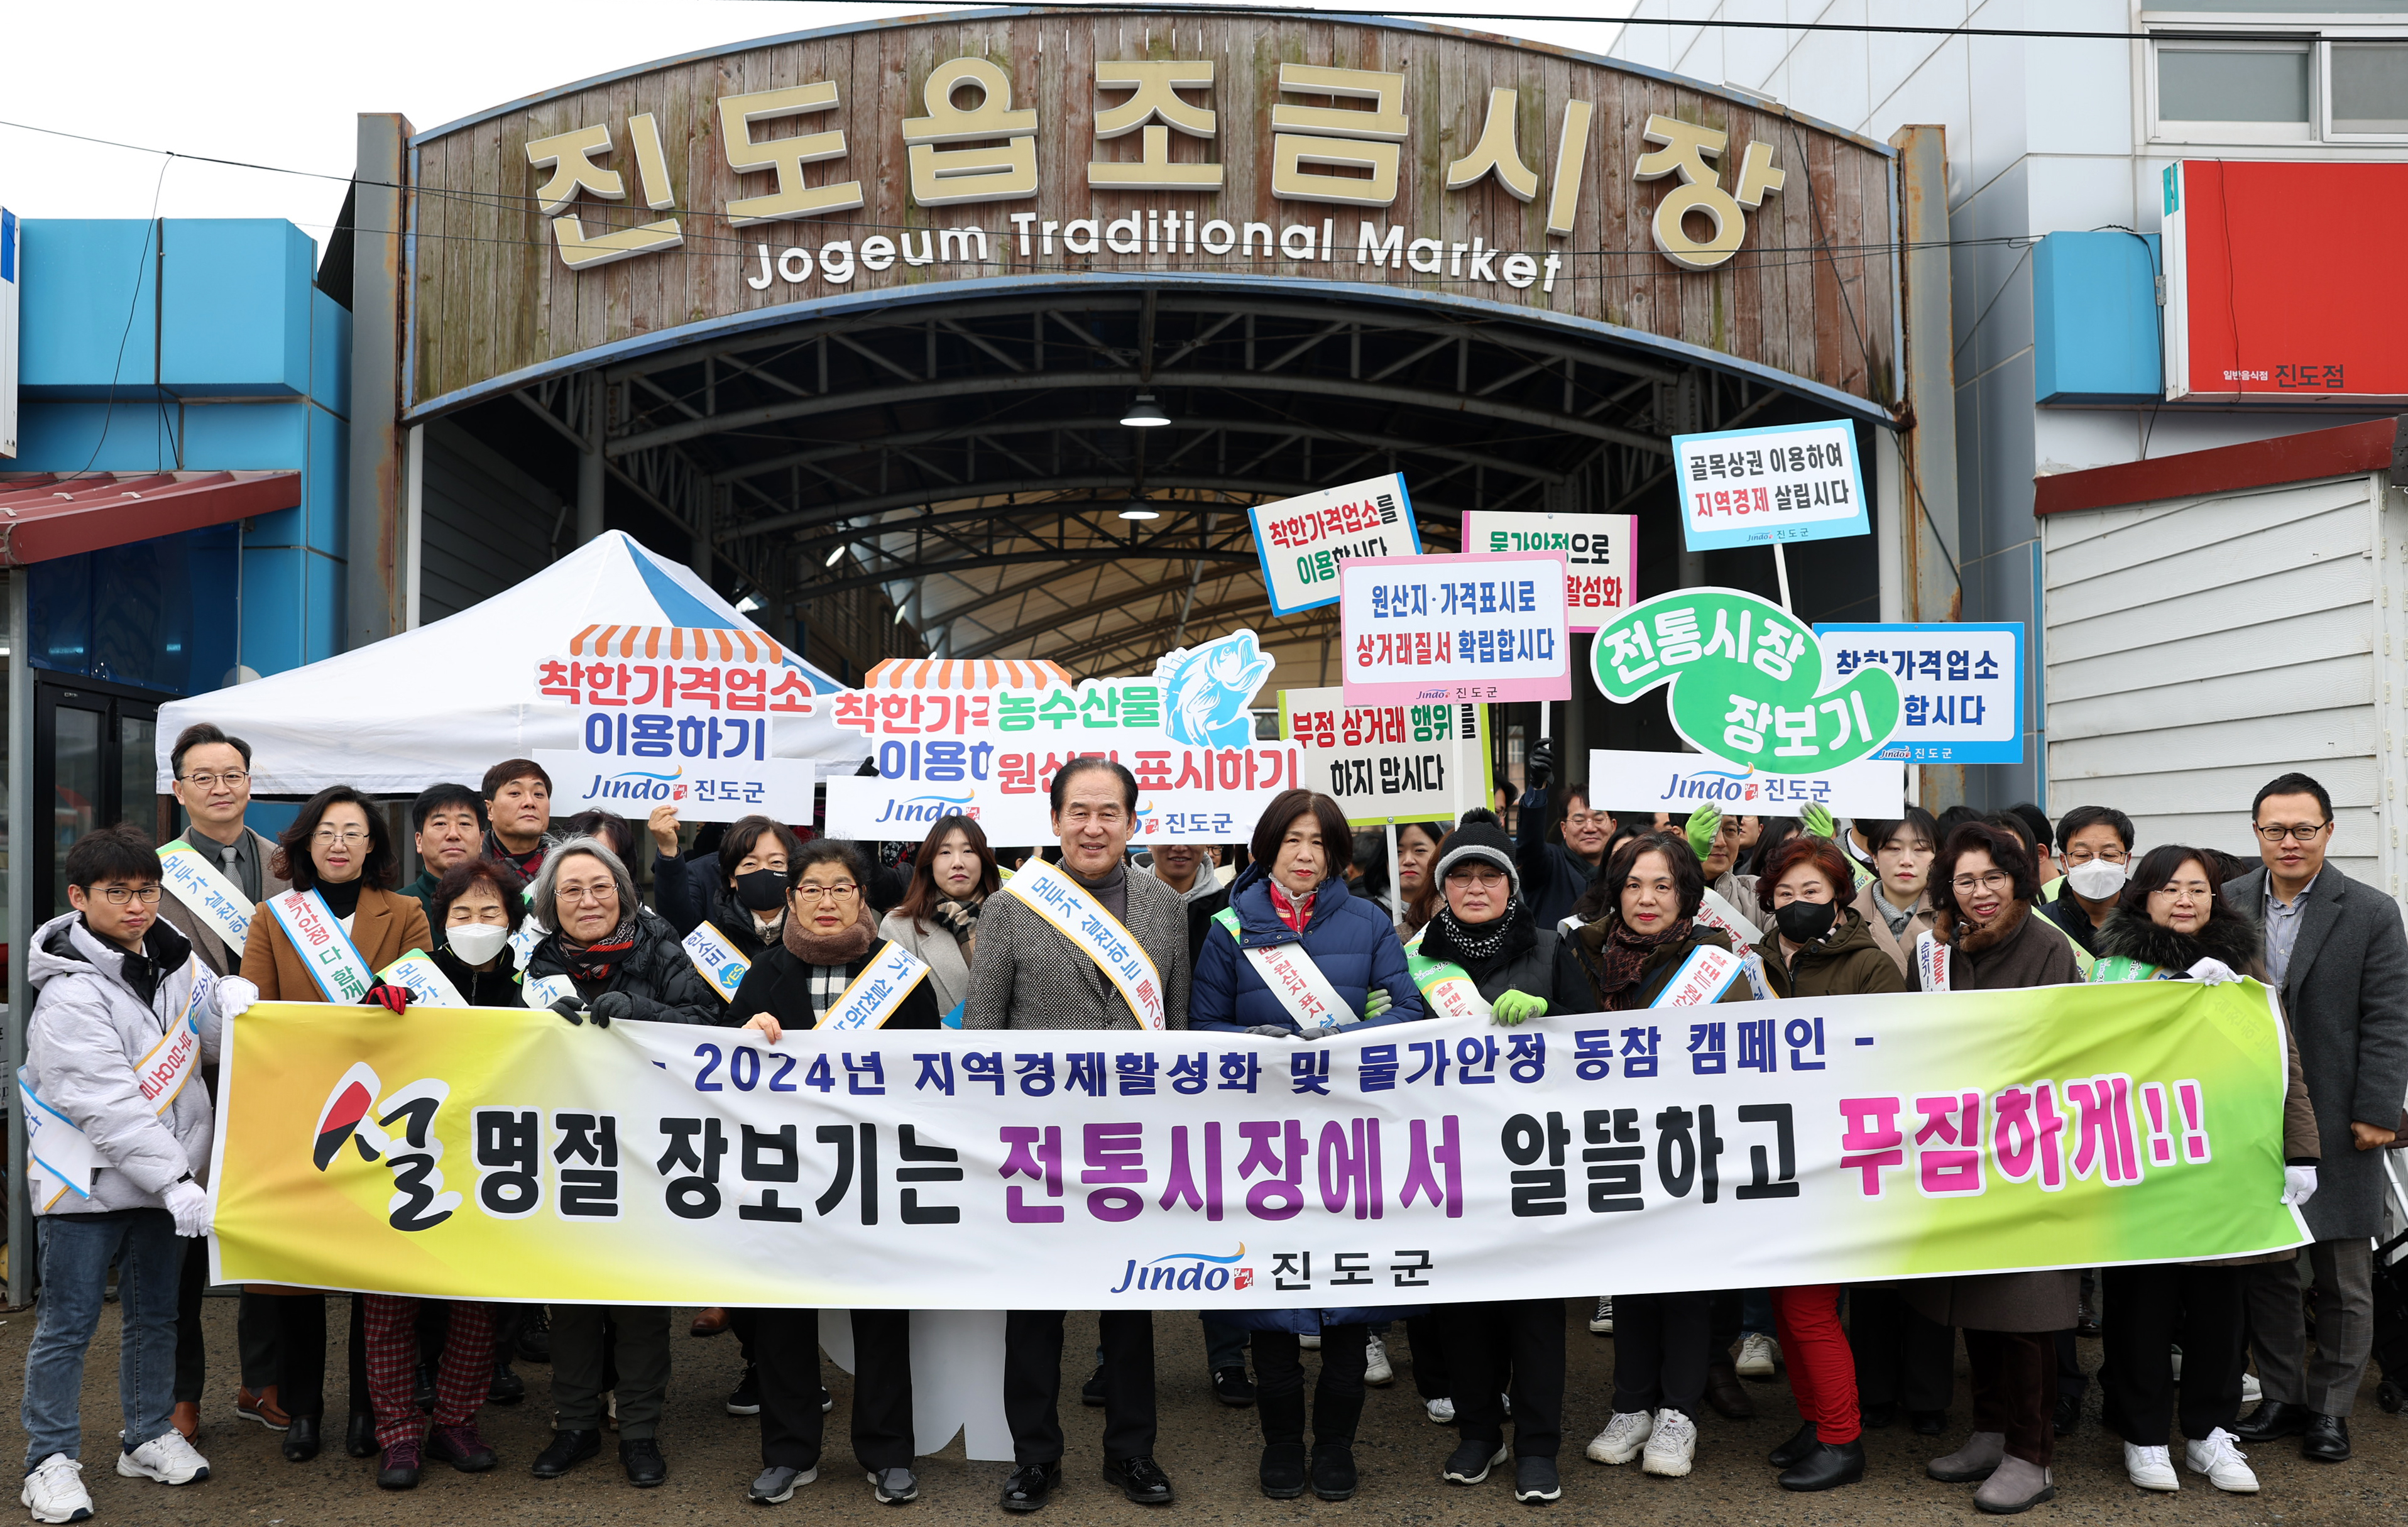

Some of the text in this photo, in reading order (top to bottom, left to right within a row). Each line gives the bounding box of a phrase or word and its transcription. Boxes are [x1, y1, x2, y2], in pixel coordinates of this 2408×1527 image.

[748, 210, 1562, 293] Jogeum Traditional Market
[2223, 364, 2344, 388] 일반음식점 진도점
[1690, 442, 1843, 481] 골목상권 이용하여
[1695, 479, 1849, 517] 지역경제 살립시다
[1269, 494, 1398, 549] 착한가격업소를
[1747, 532, 1769, 542] Jindo
[1776, 528, 1809, 540] 진도군
[1357, 628, 1555, 667] 상거래질서 확립합시다
[1604, 607, 1805, 684] 전통시장
[539, 660, 812, 713] 착한가격업소
[998, 686, 1160, 731] 농수산물
[1416, 689, 1445, 700] Jindo
[1456, 686, 1497, 699] 진도군
[585, 713, 765, 760] 이용하기
[1293, 710, 1335, 749] 부정
[1342, 706, 1406, 747] 상거래
[1723, 690, 1873, 757] 장보기
[1134, 748, 1298, 792] 표시하기
[1330, 753, 1444, 797] 하지 맙시다
[1878, 749, 1906, 759] Jindo
[1915, 748, 1952, 759] 진도군
[582, 774, 670, 801] Jindo
[694, 779, 765, 804] 진도군
[1660, 773, 1743, 800] Jindo
[1765, 779, 1832, 803] 진도군
[1165, 813, 1234, 835] 진도군
[162, 855, 209, 895] 모두가
[284, 891, 330, 946] 물가안정
[319, 946, 342, 965] 다
[1031, 876, 1082, 919] 모두가
[1081, 914, 1142, 982] 실천하는
[721, 965, 745, 986] YES
[1274, 960, 1307, 996] 원산지
[1298, 992, 1325, 1019] 표시
[140, 1030, 193, 1101] 부당요금
[694, 1043, 886, 1096] 2024년
[912, 1051, 1261, 1098] 지역경제활성화
[1291, 1051, 1332, 1096] 및
[1357, 1032, 1546, 1093] 물가안정
[1573, 1025, 1662, 1081] 동참
[1686, 1015, 1827, 1077] 캠페인
[313, 1080, 454, 1233] 설
[473, 1109, 619, 1218] 명절
[656, 1116, 965, 1226] 장보기는
[997, 1114, 1464, 1223] 전통시장에서
[1501, 1102, 1800, 1217] 알뜰하고
[1110, 1259, 1230, 1294] Jindo
[1270, 1249, 1433, 1291] 진도군
